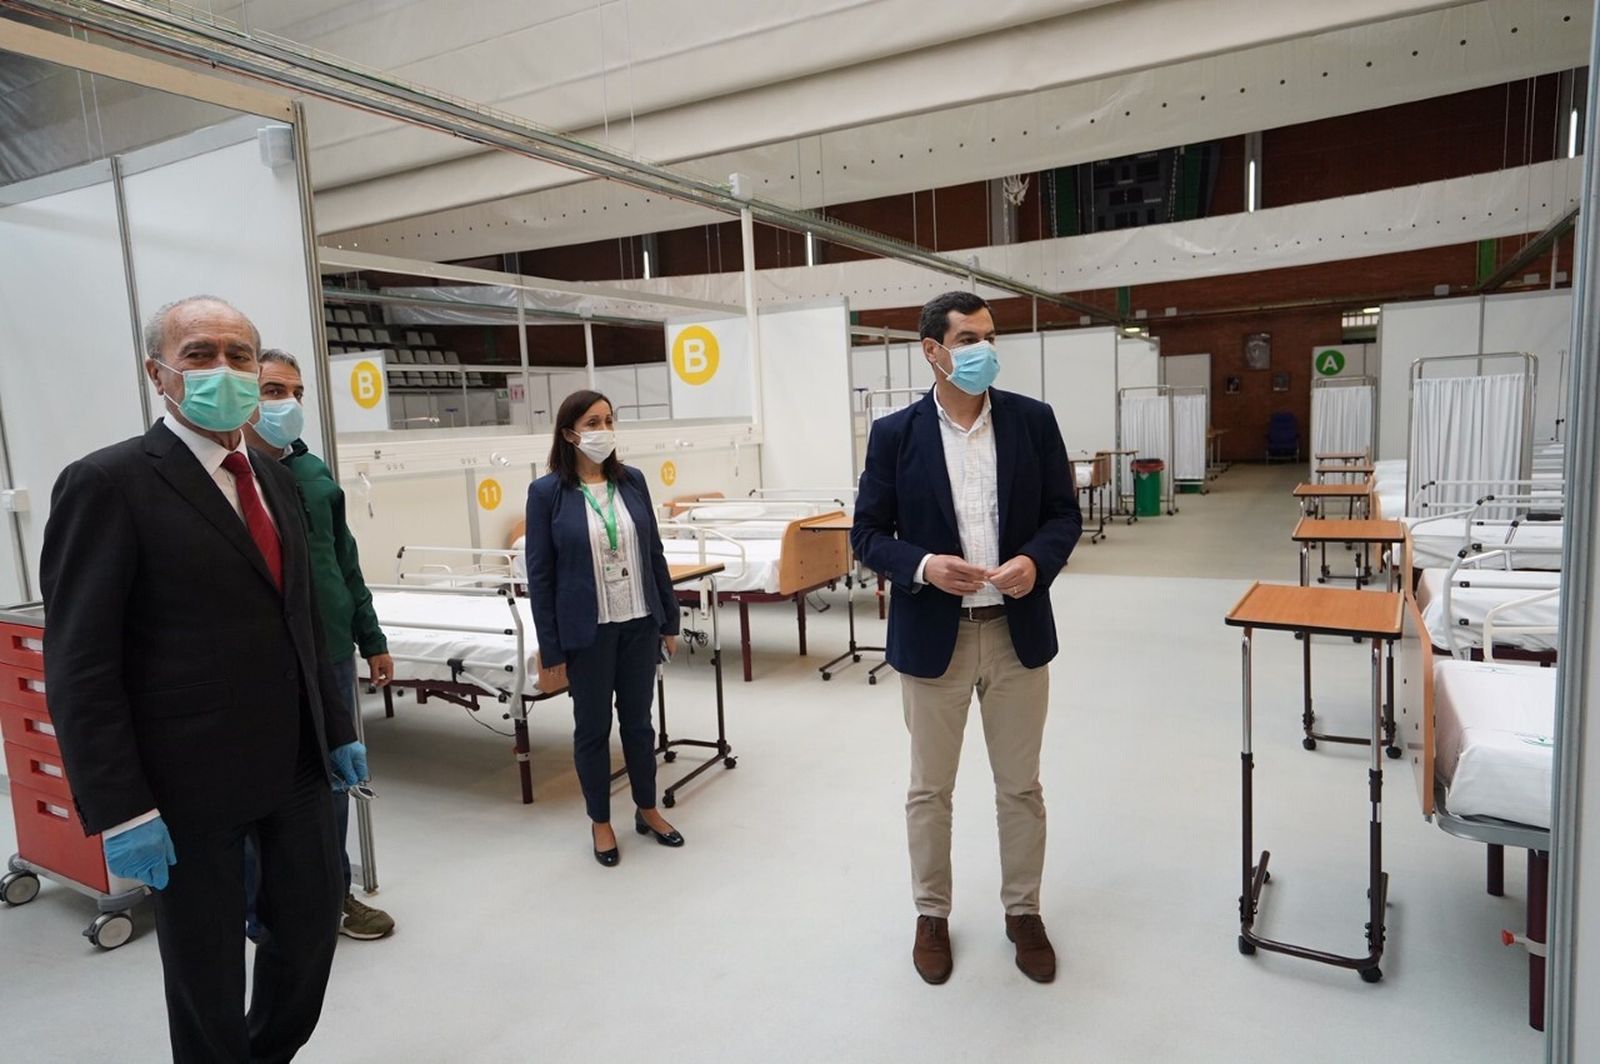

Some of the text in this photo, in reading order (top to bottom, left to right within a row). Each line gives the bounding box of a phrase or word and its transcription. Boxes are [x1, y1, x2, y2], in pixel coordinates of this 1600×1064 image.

[683, 339, 708, 373] B
[1322, 355, 1339, 371] A
[358, 370, 375, 399] B
[663, 467, 675, 481] 12
[482, 486, 498, 502] 11
